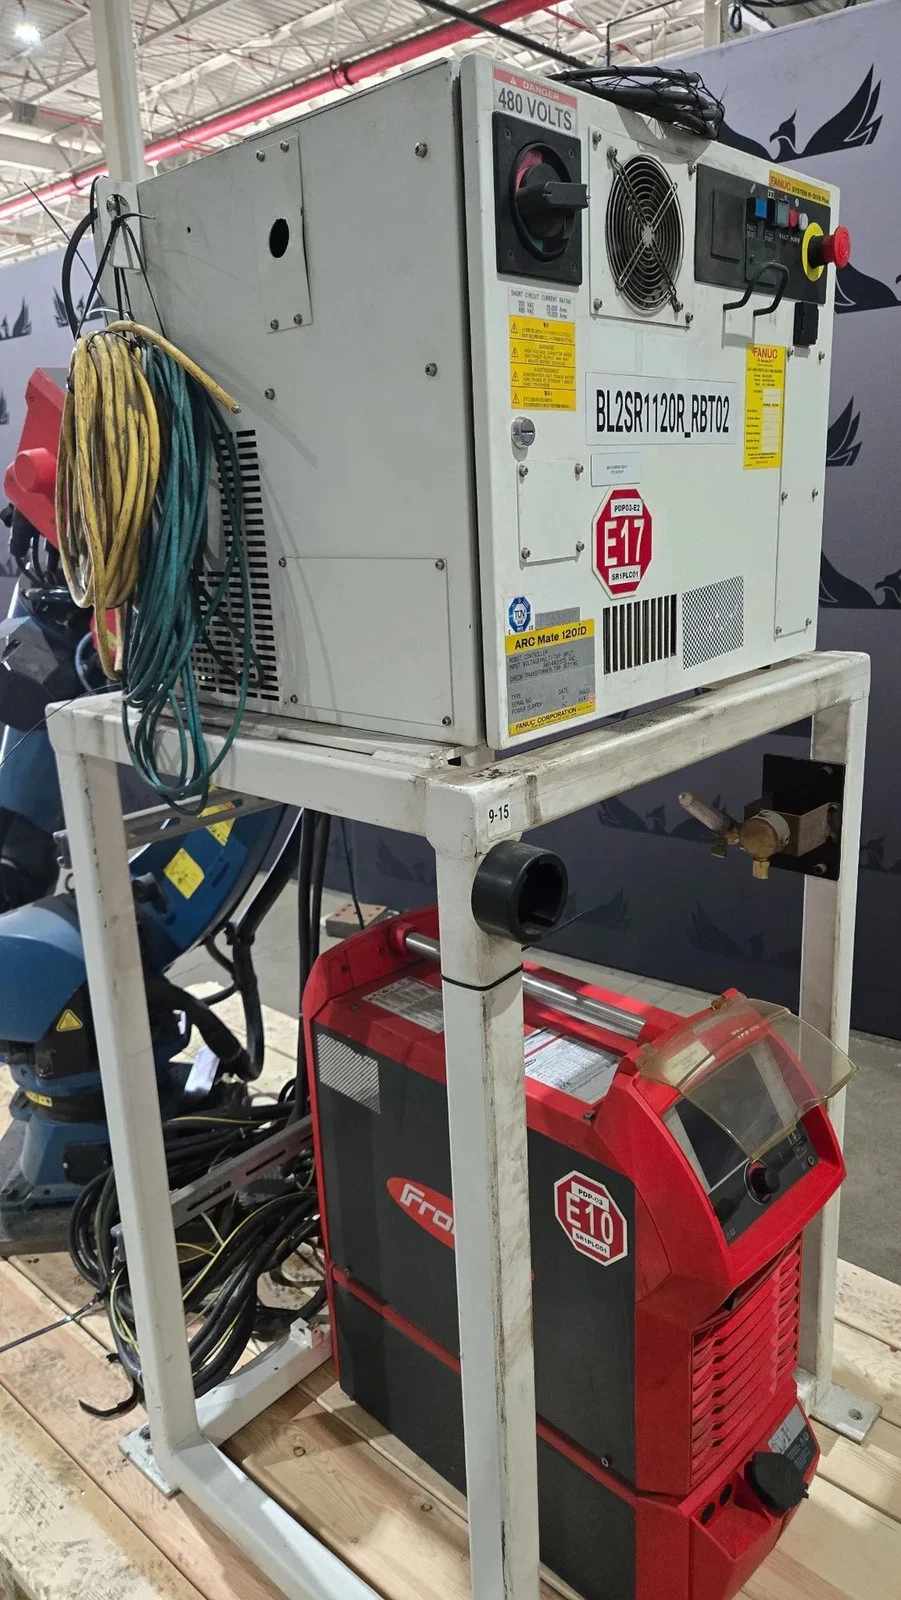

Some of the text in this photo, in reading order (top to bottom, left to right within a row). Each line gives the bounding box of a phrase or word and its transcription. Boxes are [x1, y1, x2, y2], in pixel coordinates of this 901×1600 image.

[522, 80, 560, 101] DANGER
[498, 87, 572, 131] 480 VOLTS
[770, 175, 792, 191] FANUC
[510, 289, 523, 297] SHORT
[753, 346, 778, 359] FANUC
[596, 389, 730, 439] BL2SR1120R_RBT02
[604, 518, 645, 567] E17
[611, 570, 639, 581] SR1PLC01
[515, 636, 535, 650] ARC
[537, 633, 560, 645] Mate
[515, 718, 536, 731] FANUC
[537, 706, 577, 724] CORPORATION
[488, 803, 510, 824] 9-15
[578, 1187, 604, 1206] PDP-03
[400, 1182, 455, 1236] Fro
[566, 1191, 614, 1245] E10
[575, 1232, 608, 1254] SR1PLC01
